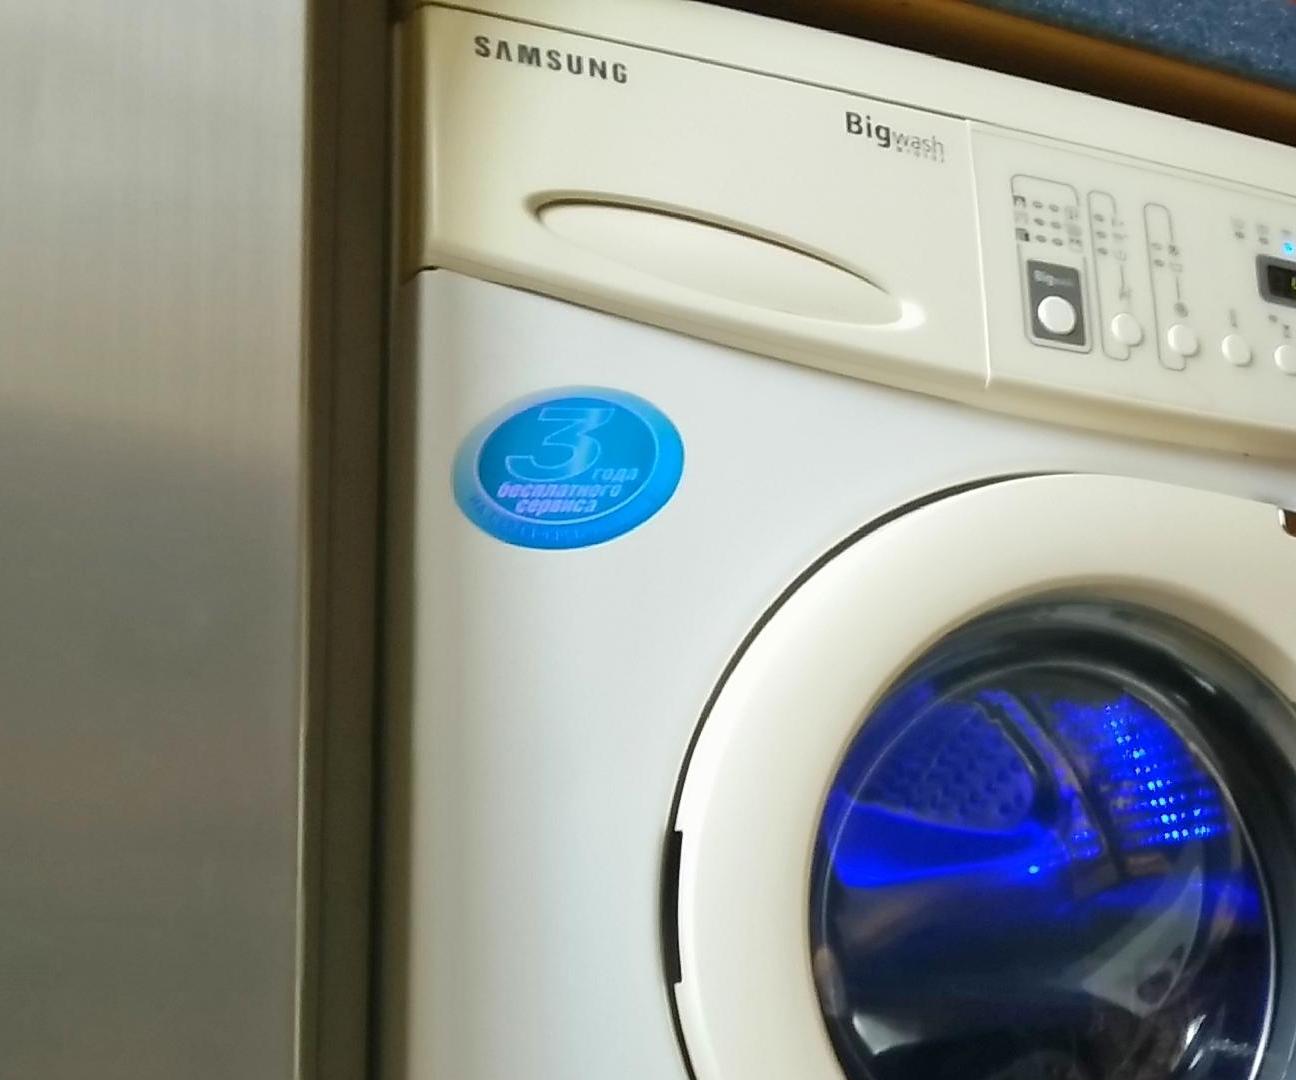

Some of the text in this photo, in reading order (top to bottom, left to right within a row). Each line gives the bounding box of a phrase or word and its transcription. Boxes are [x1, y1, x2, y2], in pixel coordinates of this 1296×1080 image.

[474, 35, 628, 84] SAMSUNG
[505, 407, 615, 482] 3
[592, 467, 638, 481] года
[515, 499, 598, 516] сервиса
